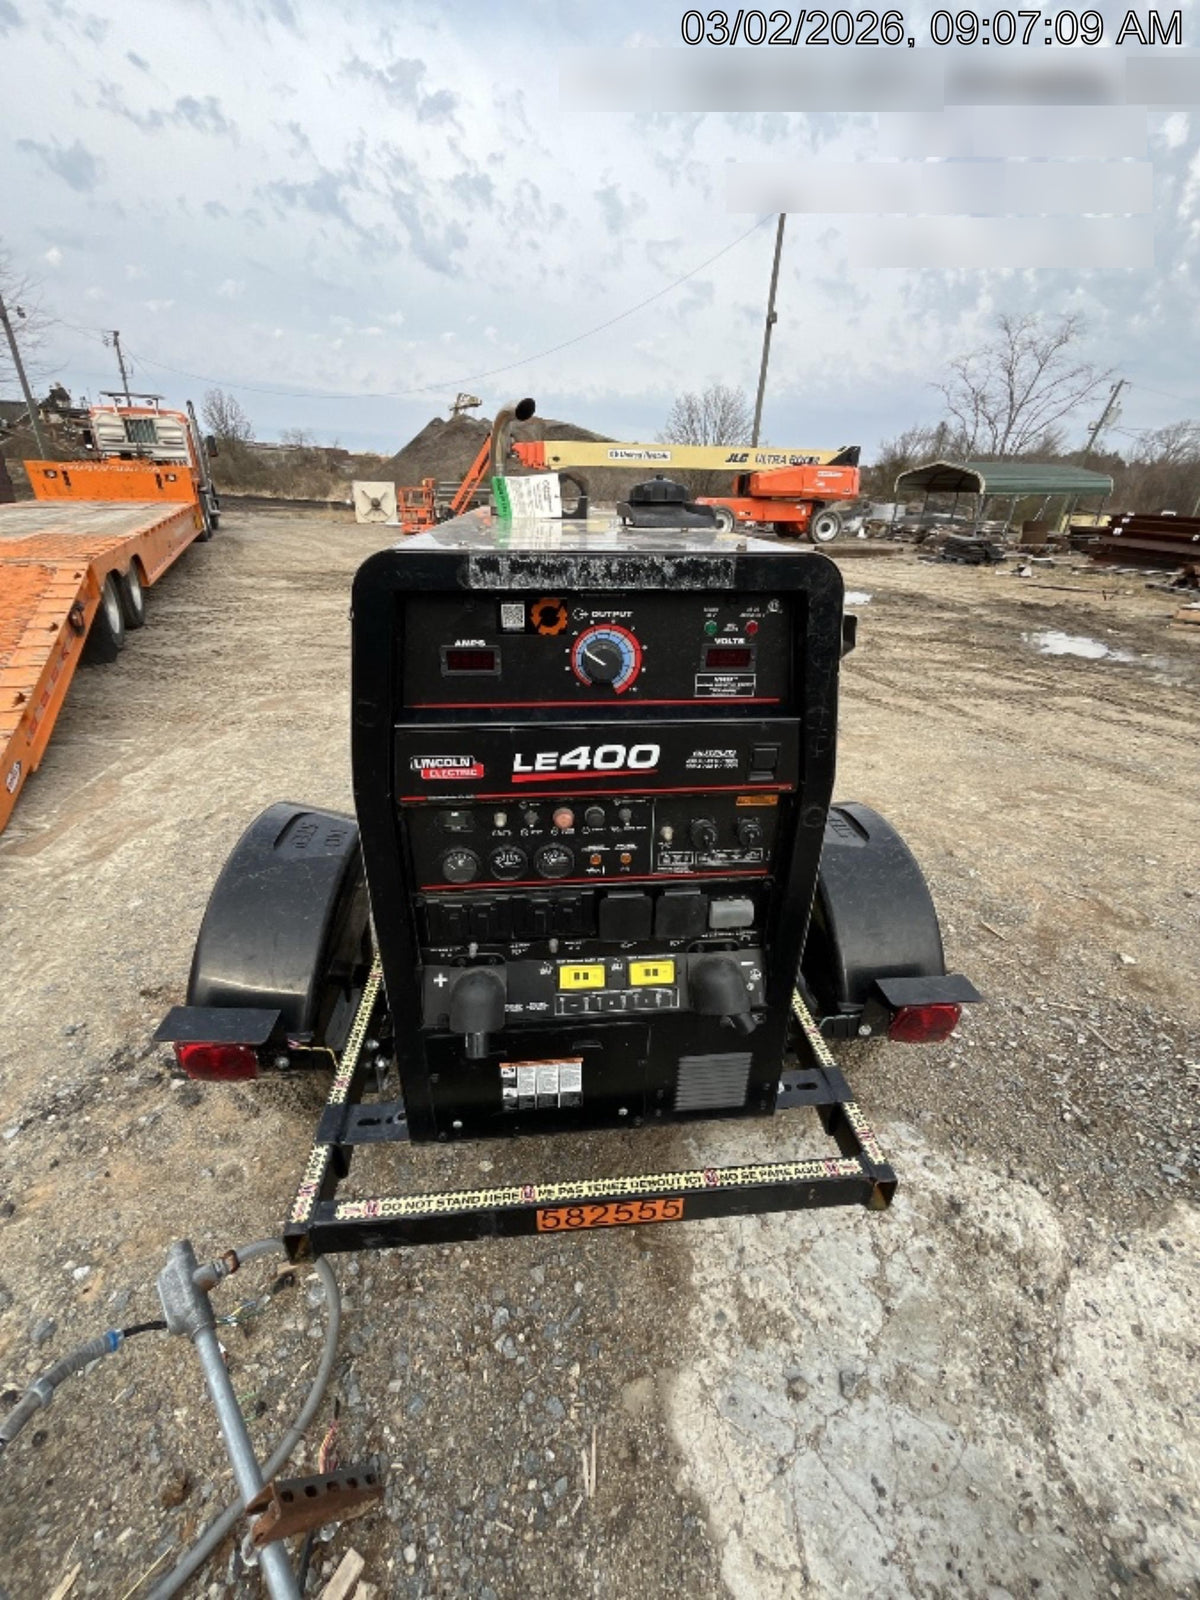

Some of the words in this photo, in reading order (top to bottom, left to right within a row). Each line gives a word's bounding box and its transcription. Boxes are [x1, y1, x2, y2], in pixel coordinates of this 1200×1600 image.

[454, 639, 486, 647] AMPS
[413, 758, 471, 769] LINCOLN
[513, 745, 661, 772] LE400
[558, 1186, 583, 1195] PAS
[381, 1203, 401, 1211] DO
[405, 1199, 433, 1210] NOT
[437, 1195, 480, 1208] STAND
[541, 1200, 680, 1229] 582555
